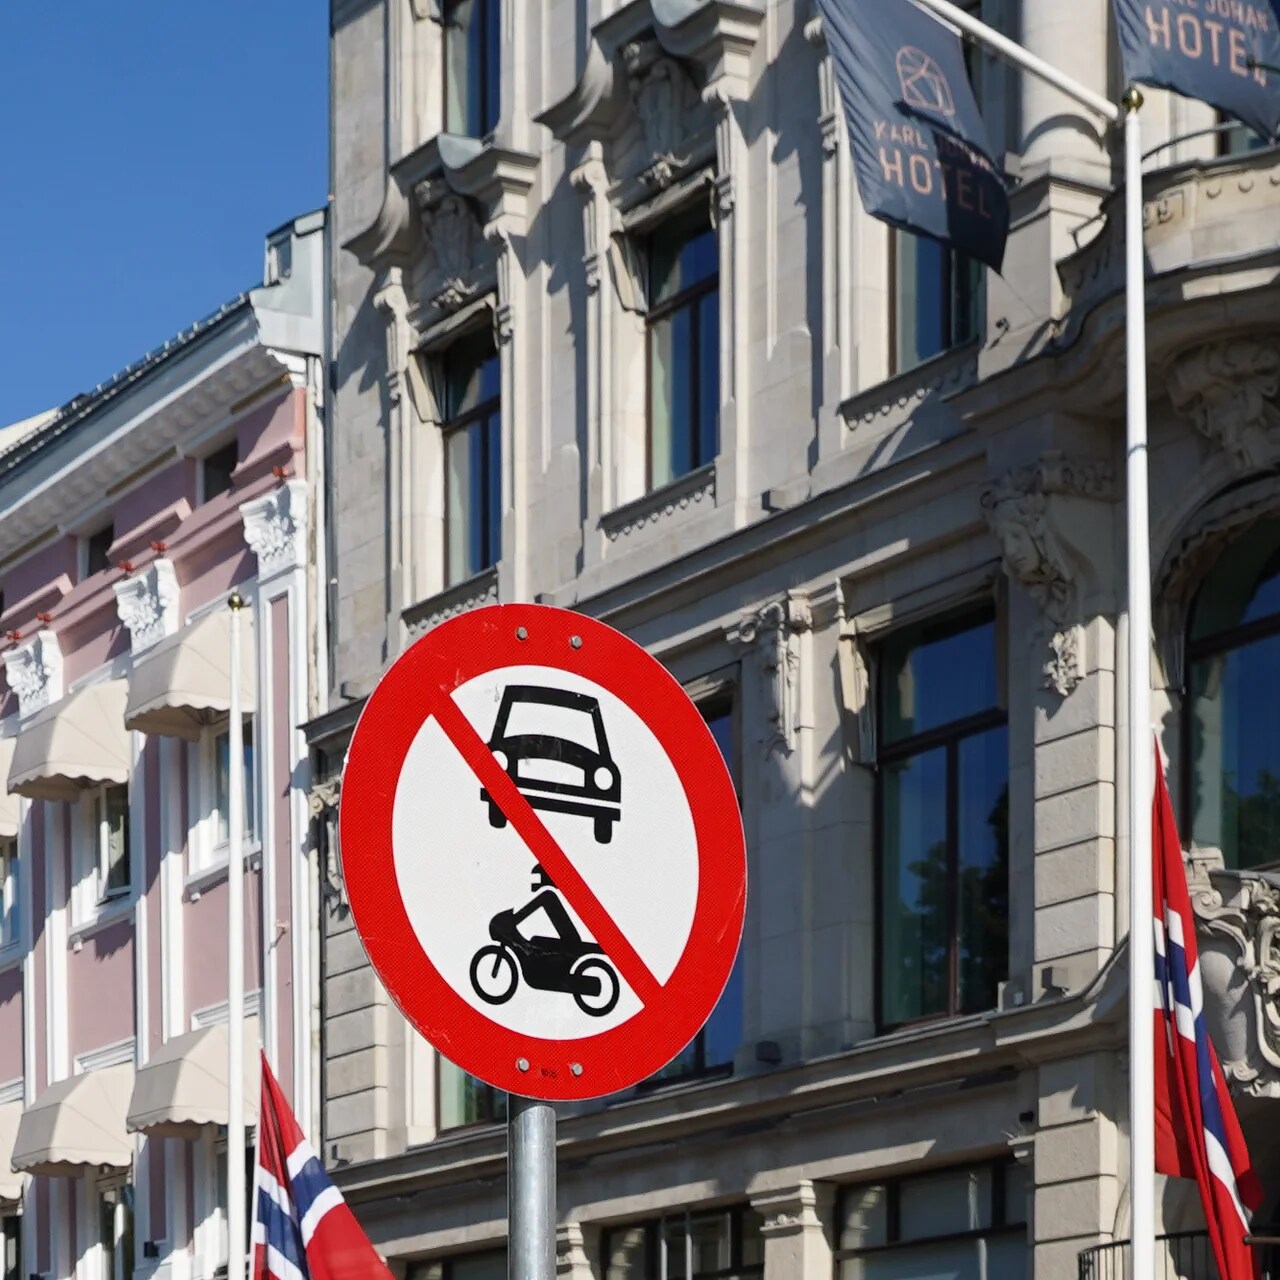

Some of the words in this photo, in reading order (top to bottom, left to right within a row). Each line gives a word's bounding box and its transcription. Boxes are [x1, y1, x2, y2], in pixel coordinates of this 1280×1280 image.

[1145, 5, 1267, 87] HOTEL
[873, 120, 928, 149] KARL
[879, 147, 992, 220] HOTEL
